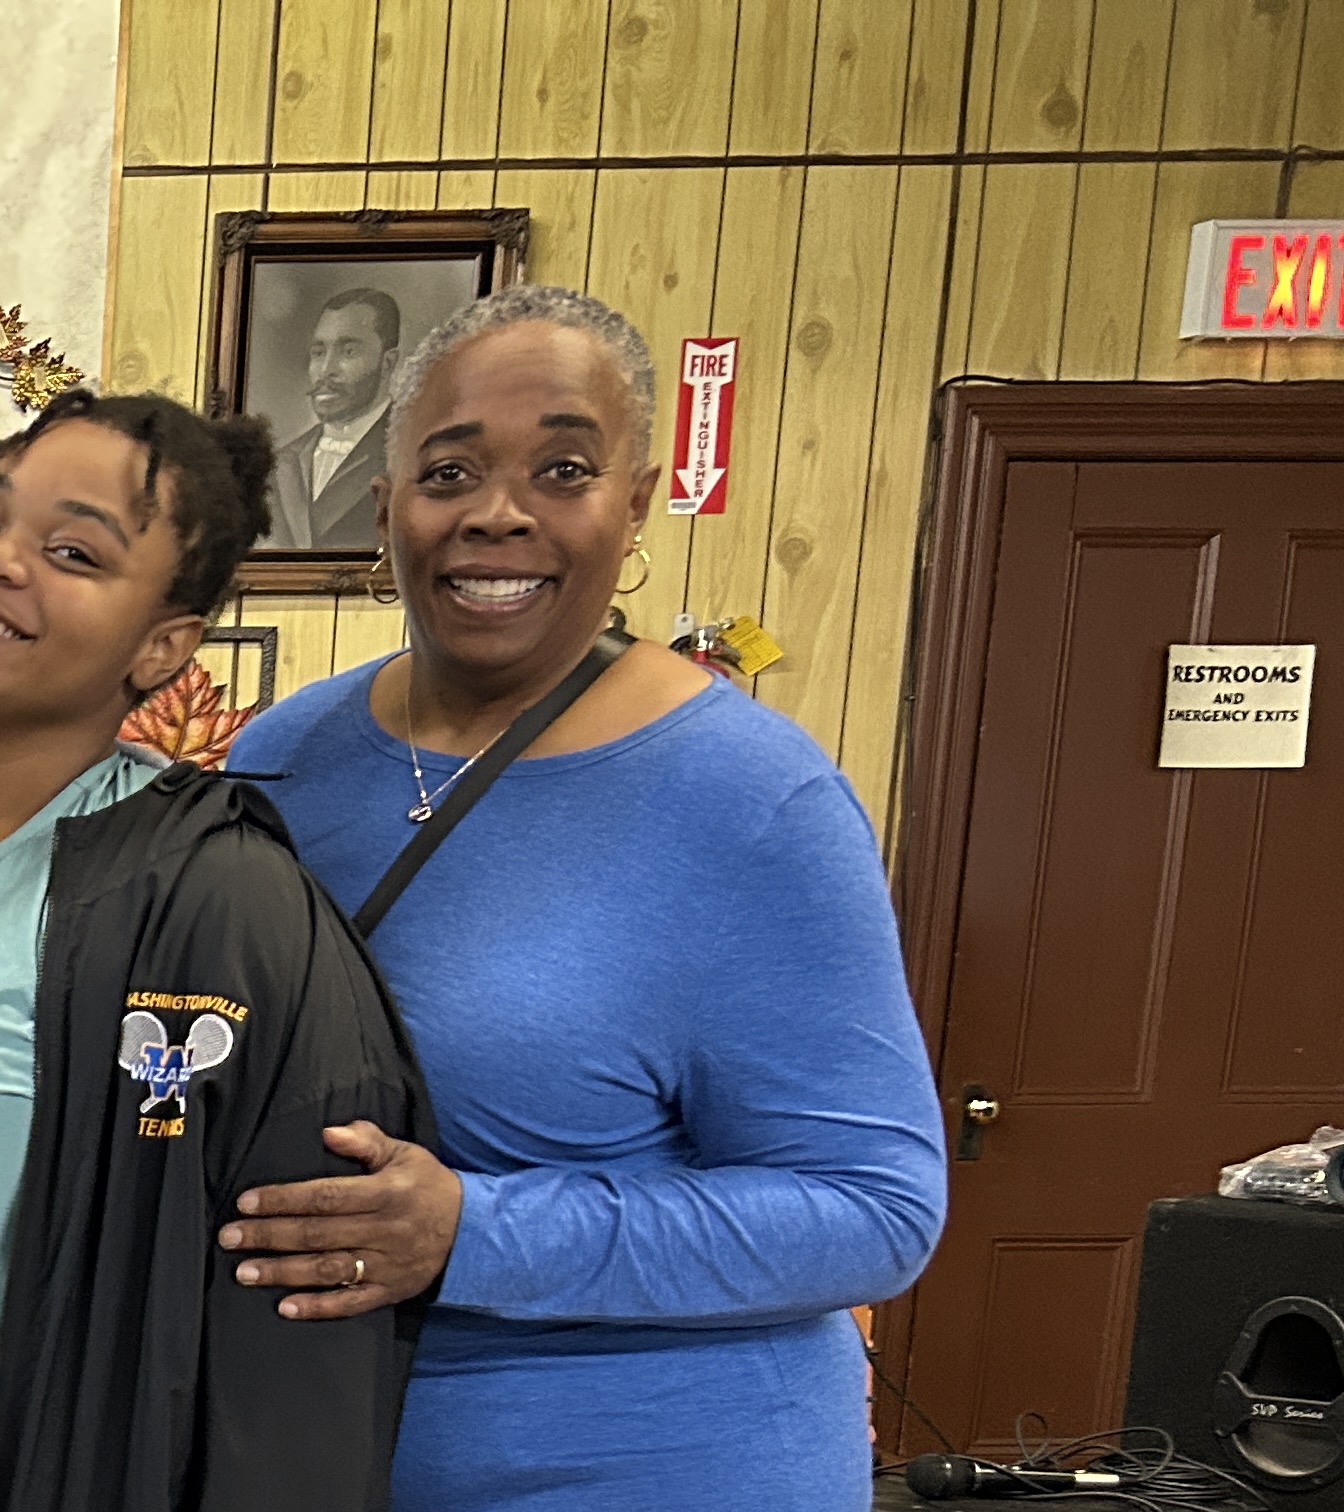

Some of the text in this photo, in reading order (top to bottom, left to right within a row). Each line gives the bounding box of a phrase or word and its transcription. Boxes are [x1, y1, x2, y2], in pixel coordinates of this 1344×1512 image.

[689, 354, 730, 378] FIRE
[693, 381, 713, 499] EXTINGUISHER
[1173, 664, 1303, 684] RESTROOMS
[1212, 692, 1245, 705] AND
[1167, 709, 1300, 722] EMERGENCY EXITS
